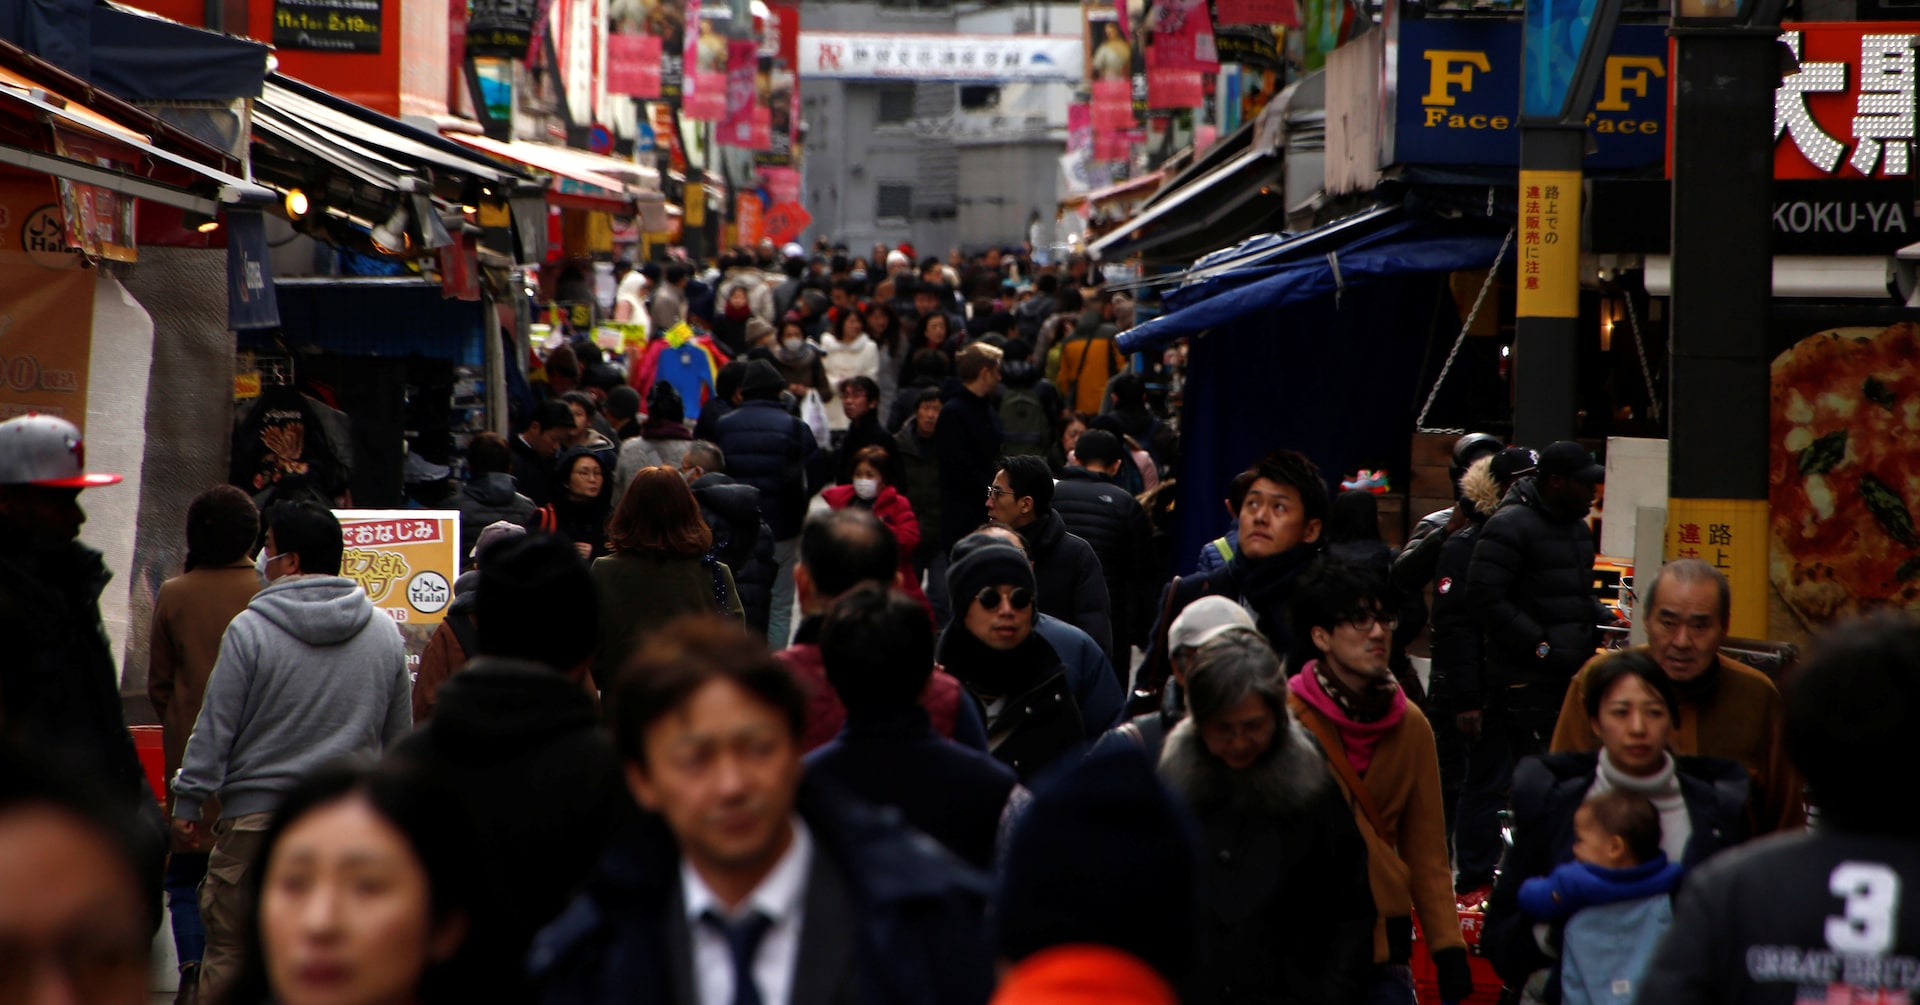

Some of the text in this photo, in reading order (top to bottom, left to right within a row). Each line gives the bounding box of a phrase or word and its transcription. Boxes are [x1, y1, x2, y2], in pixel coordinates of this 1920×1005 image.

[1421, 49, 1491, 106] F
[1596, 55, 1665, 111] F
[1423, 107, 1509, 130] Face
[1525, 185, 1541, 290] 違法販売に注意
[1544, 185, 1559, 244] 路上での
[412, 593, 446, 603] Halal
[1823, 860, 1902, 956] 3
